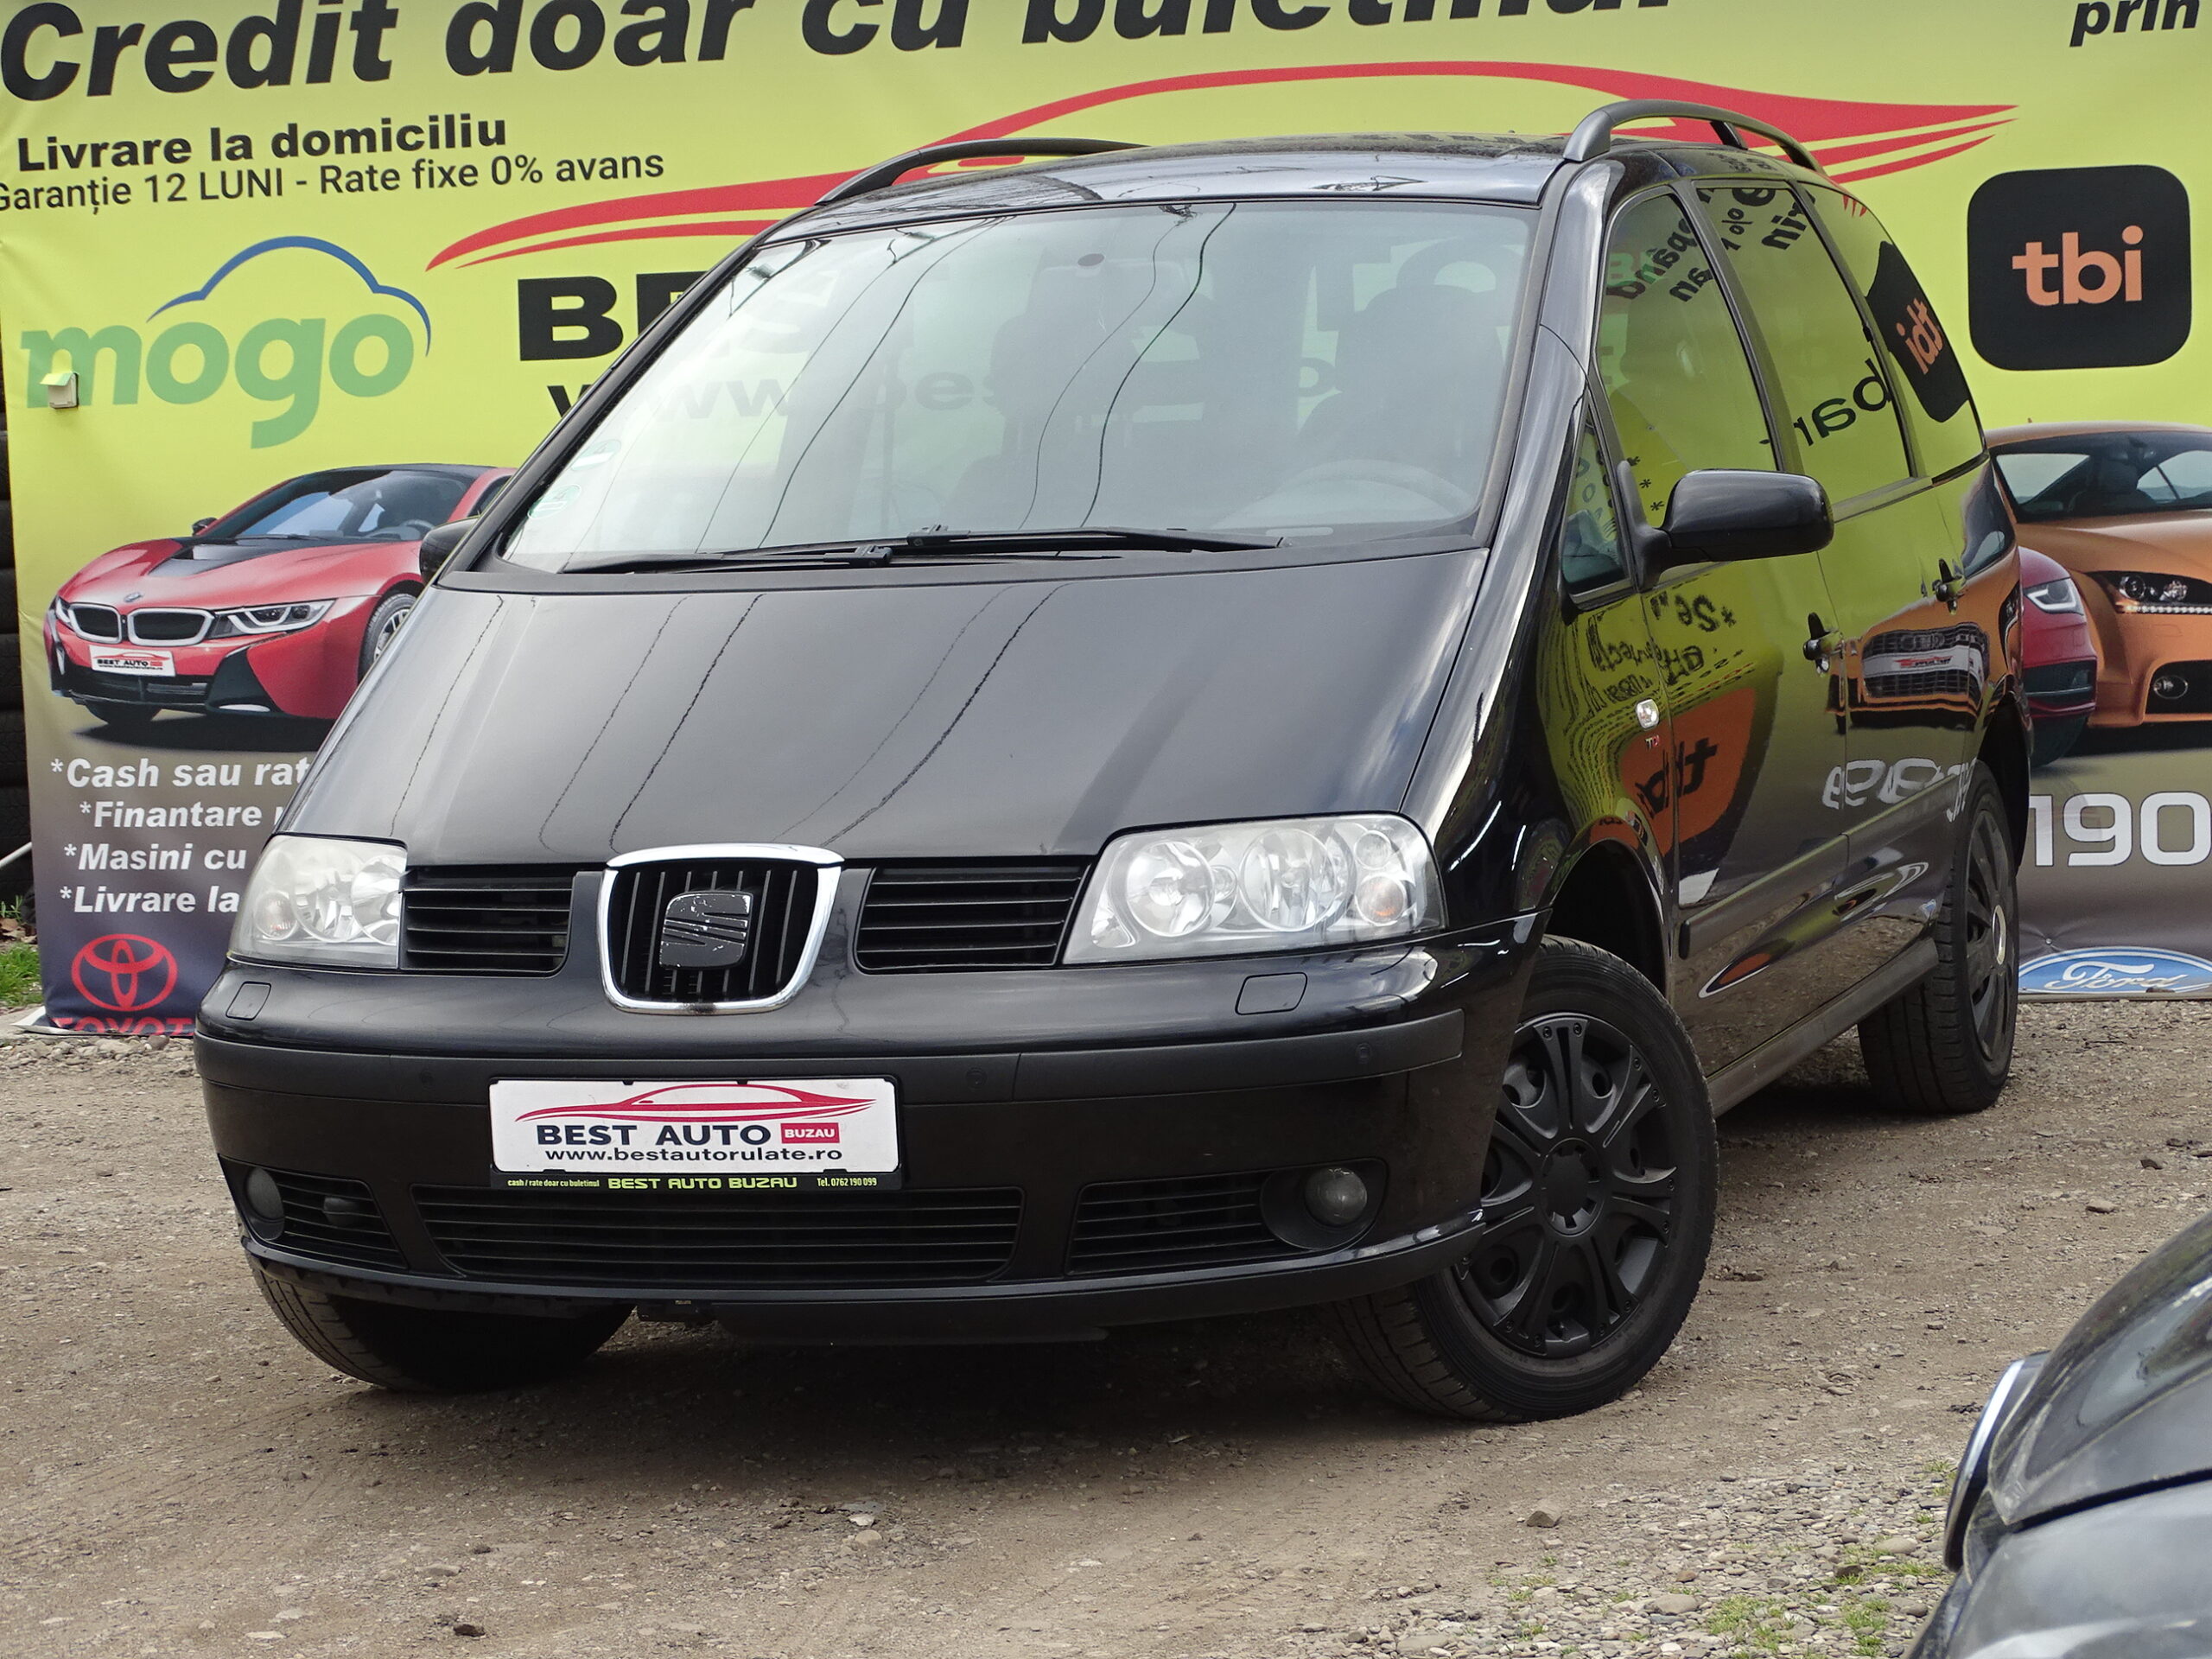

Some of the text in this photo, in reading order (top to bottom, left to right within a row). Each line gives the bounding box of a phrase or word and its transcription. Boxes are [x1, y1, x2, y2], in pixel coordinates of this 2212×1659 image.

[2069, 0, 2200, 48] prin
[2, 0, 400, 102] Credit
[444, 0, 755, 77] doar
[802, 0, 969, 57] cu
[17, 112, 506, 172] Livrare la domiciliu
[0, 175, 132, 215] Garanție
[144, 172, 188, 203] 12
[199, 167, 283, 200] LUNI
[320, 163, 401, 194] Rate
[410, 157, 479, 189] fixe
[491, 154, 543, 185] 0%
[556, 153, 664, 182] avans
[2012, 225, 2144, 307] tbi
[20, 313, 416, 450] mogo
[172, 764, 242, 787] sau
[2028, 791, 2212, 867] 190
[204, 849, 247, 870] cu
[207, 886, 240, 913] la
[2044, 960, 2190, 989] Ford
[536, 1124, 836, 1146] BEST AUTO BUZAU
[545, 1147, 842, 1161] www.bestautorulate.ro
[543, 1179, 559, 1187] doar
[569, 1179, 601, 1187] buletinul
[607, 1178, 661, 1190] BEST
[667, 1178, 722, 1190] AUTO
[728, 1177, 798, 1189] BUZAU
